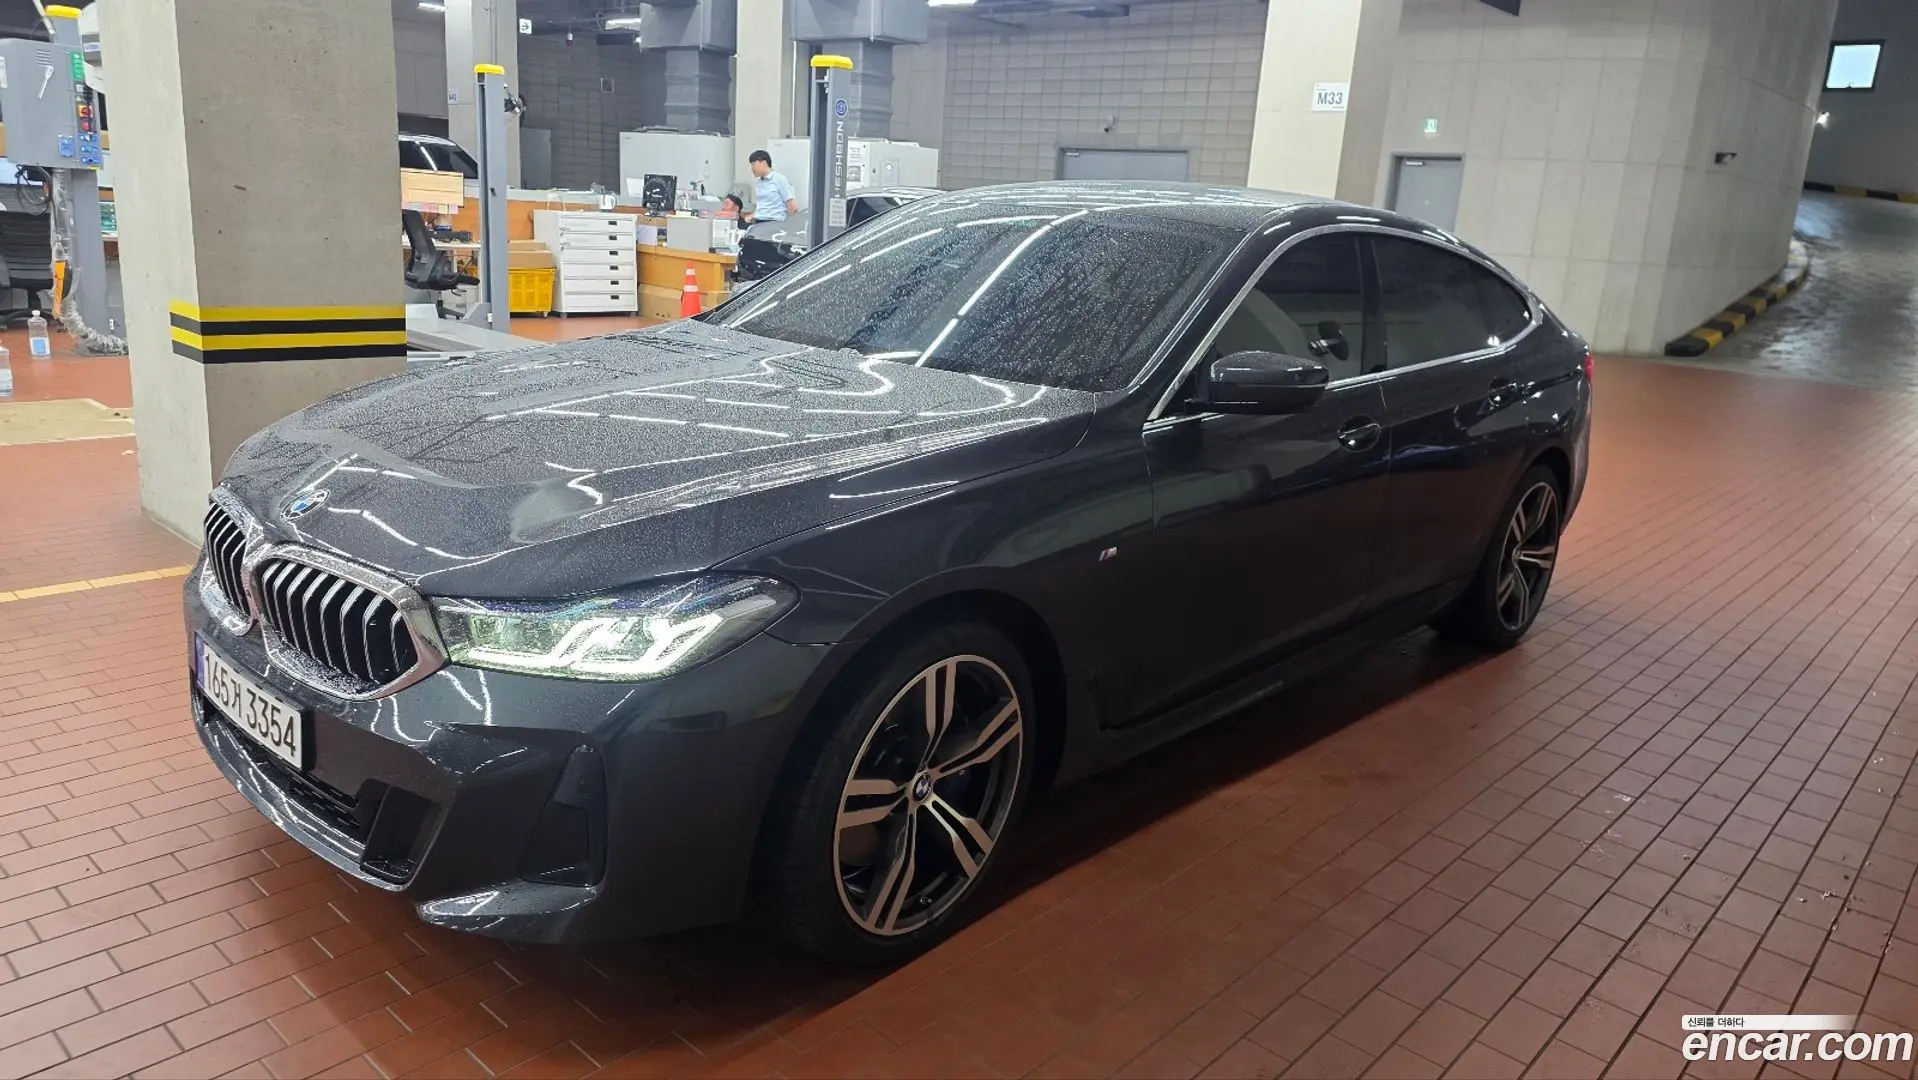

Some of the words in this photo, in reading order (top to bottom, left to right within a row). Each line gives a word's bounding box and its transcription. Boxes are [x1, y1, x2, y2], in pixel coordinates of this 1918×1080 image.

[1317, 92, 1343, 105] M33
[835, 120, 844, 199] HESHBON
[205, 653, 242, 718] 165거
[246, 687, 296, 757] 3354
